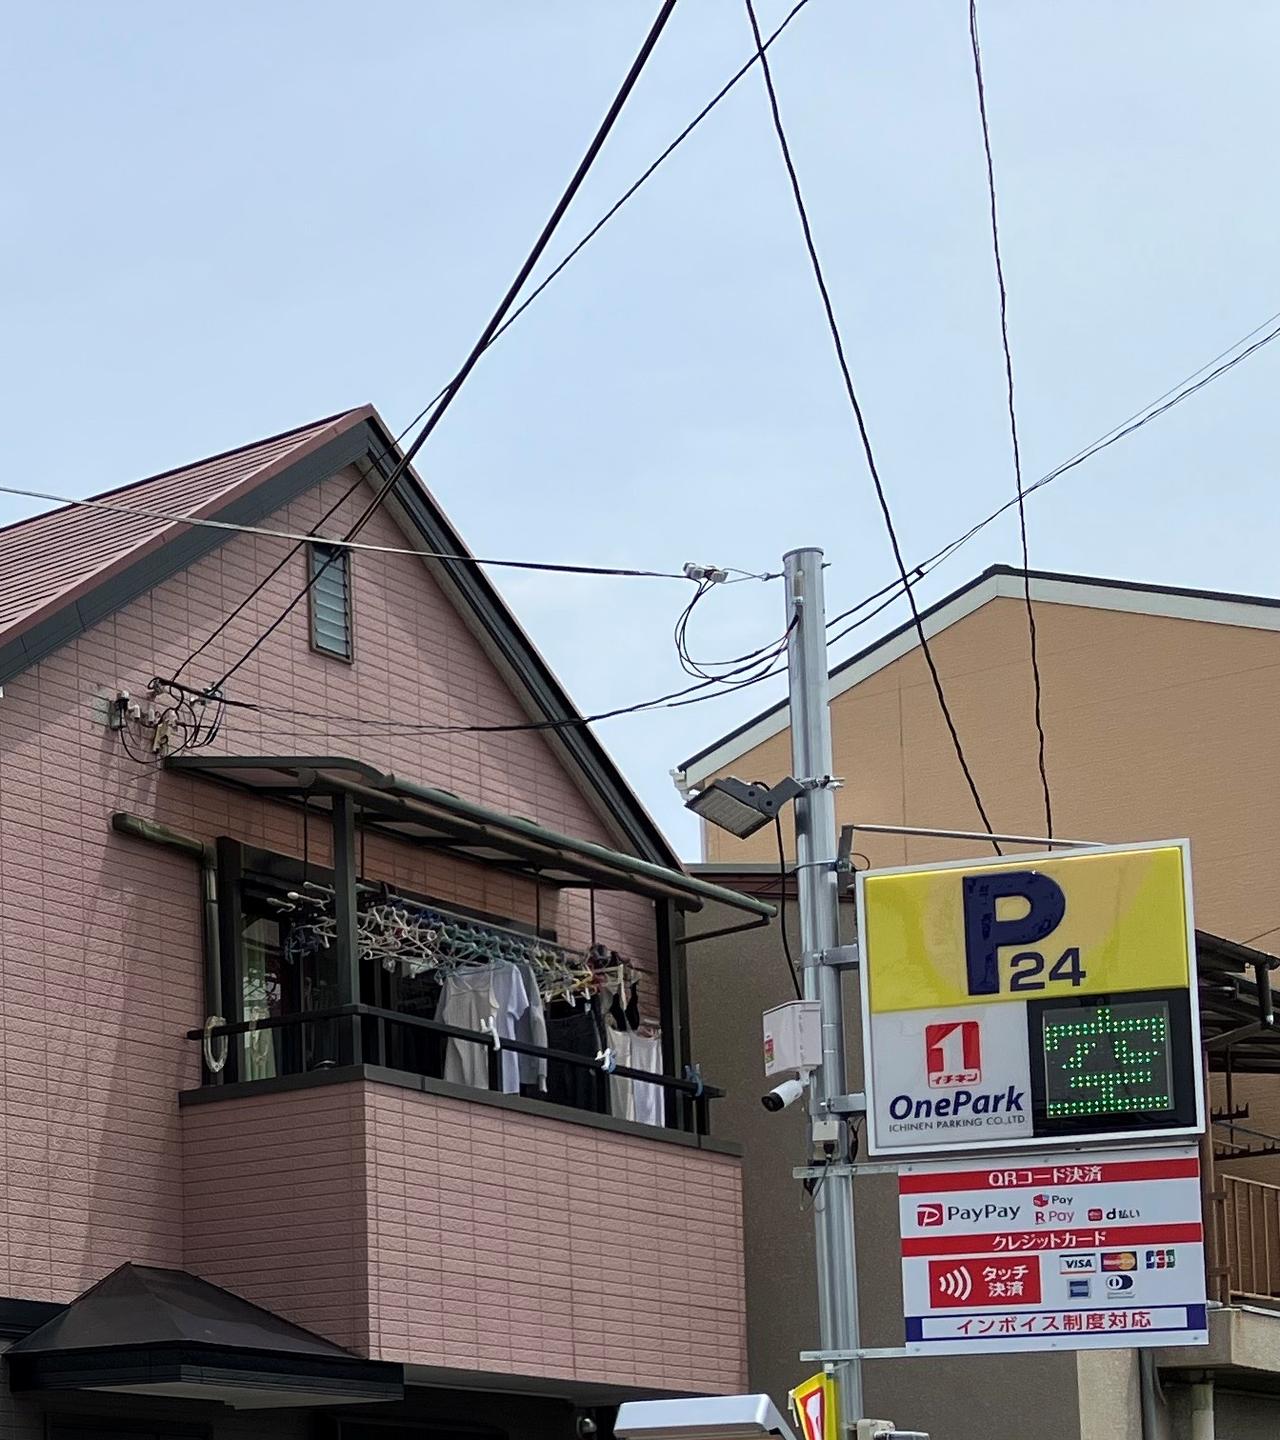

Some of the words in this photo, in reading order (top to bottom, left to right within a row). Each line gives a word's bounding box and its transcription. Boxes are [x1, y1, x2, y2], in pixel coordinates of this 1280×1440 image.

[962, 870, 1066, 996] P
[1010, 947, 1087, 992] 24
[1045, 1008, 1169, 1116] 空
[931, 1073, 978, 1085] イチネン
[889, 1086, 1025, 1120] OnePark
[889, 1121, 933, 1133] ICHINEN
[936, 1117, 983, 1129] PARKING
[988, 1165, 1103, 1187] QRコード決済
[946, 1203, 1021, 1222] PayPay
[991, 1231, 1107, 1252] クレジットカード
[981, 1264, 1030, 1282] タッチ
[1065, 1258, 1093, 1269] VISA
[988, 1281, 1025, 1298] 決済
[956, 1310, 1152, 1336] インボイス制度対応
